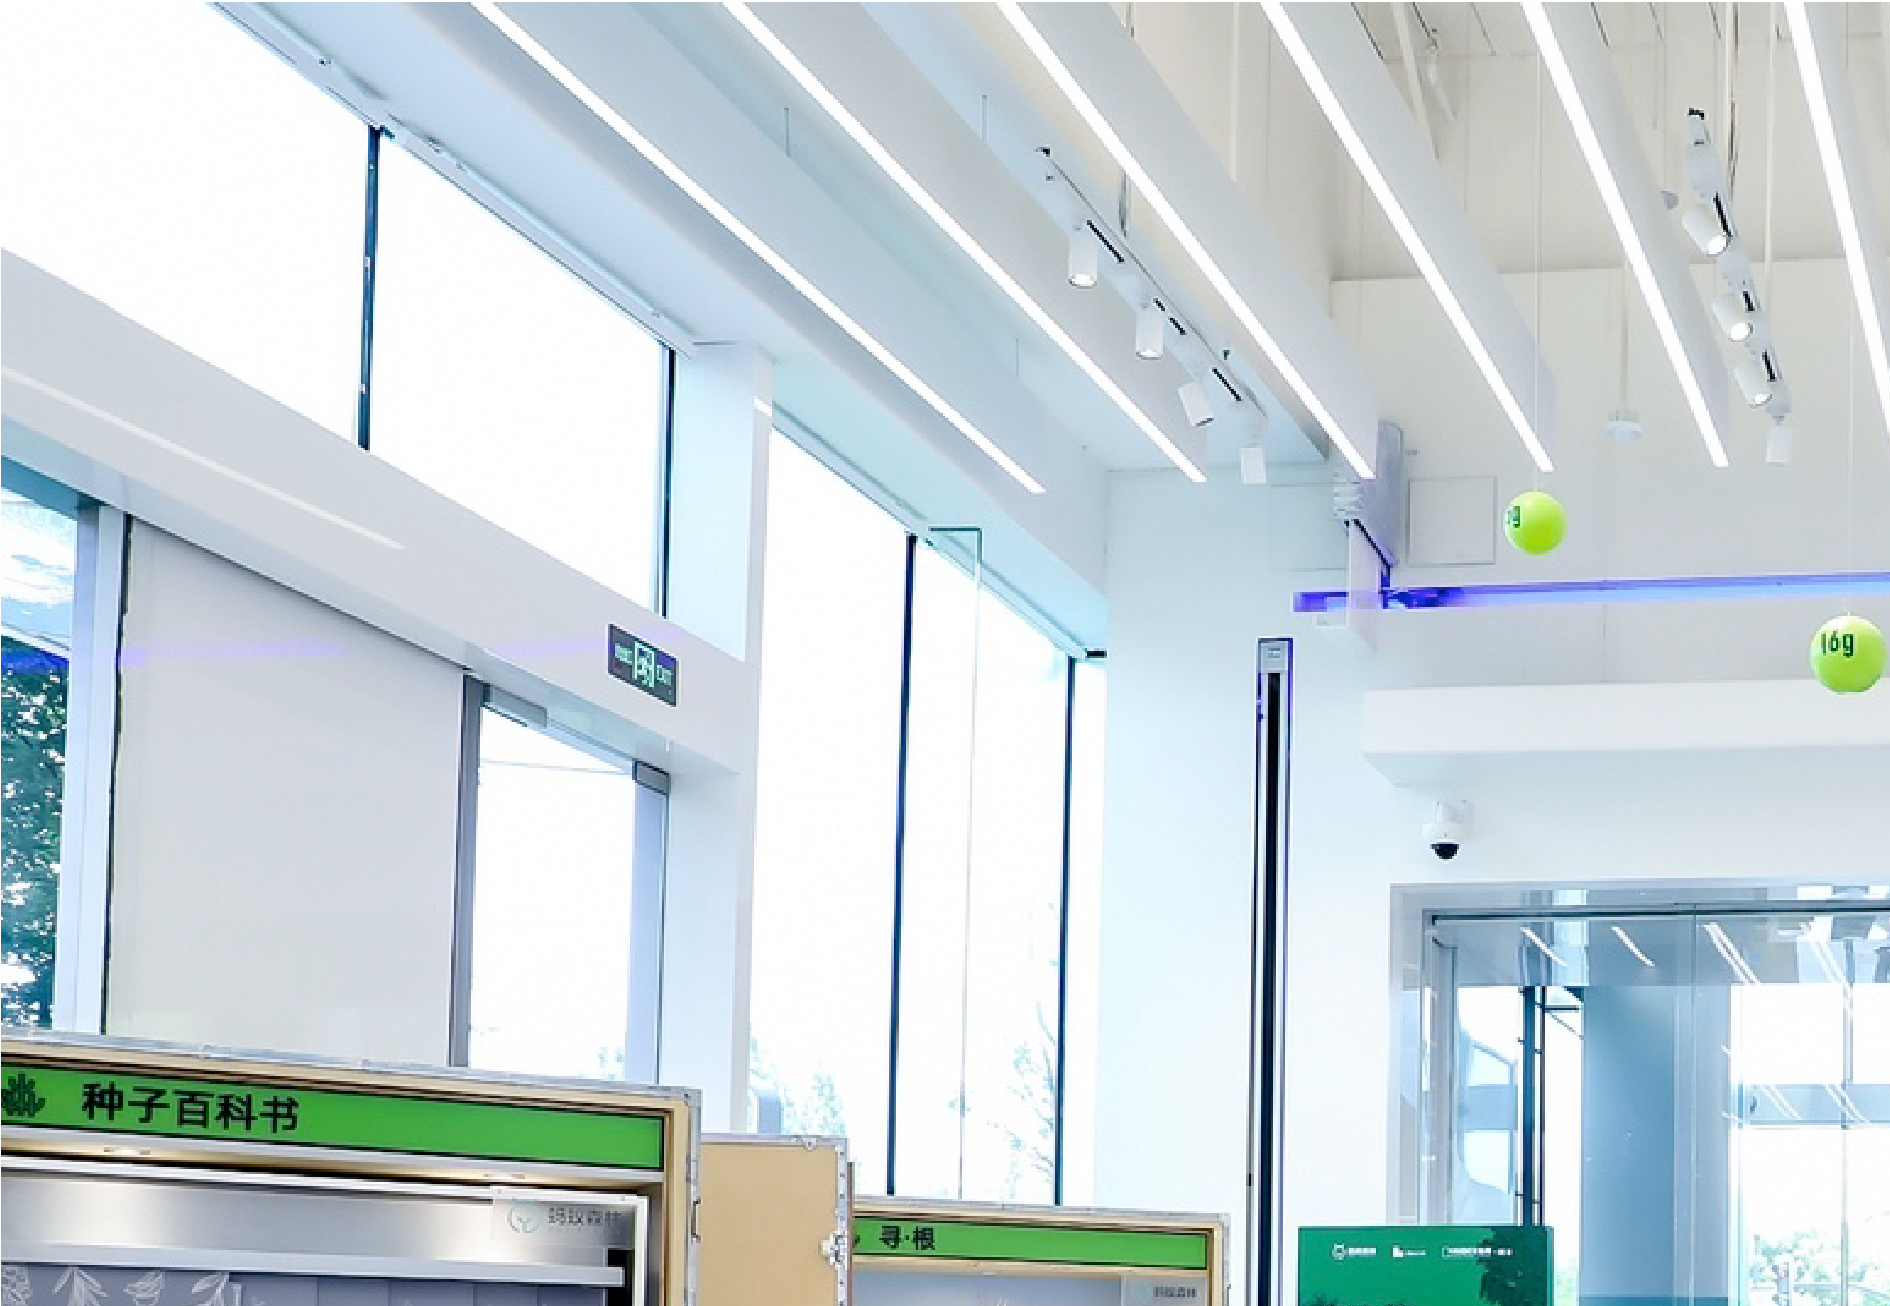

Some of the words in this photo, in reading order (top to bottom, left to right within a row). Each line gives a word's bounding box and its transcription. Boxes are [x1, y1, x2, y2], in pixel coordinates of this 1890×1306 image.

[82, 1082, 298, 1133] 种子百科书
